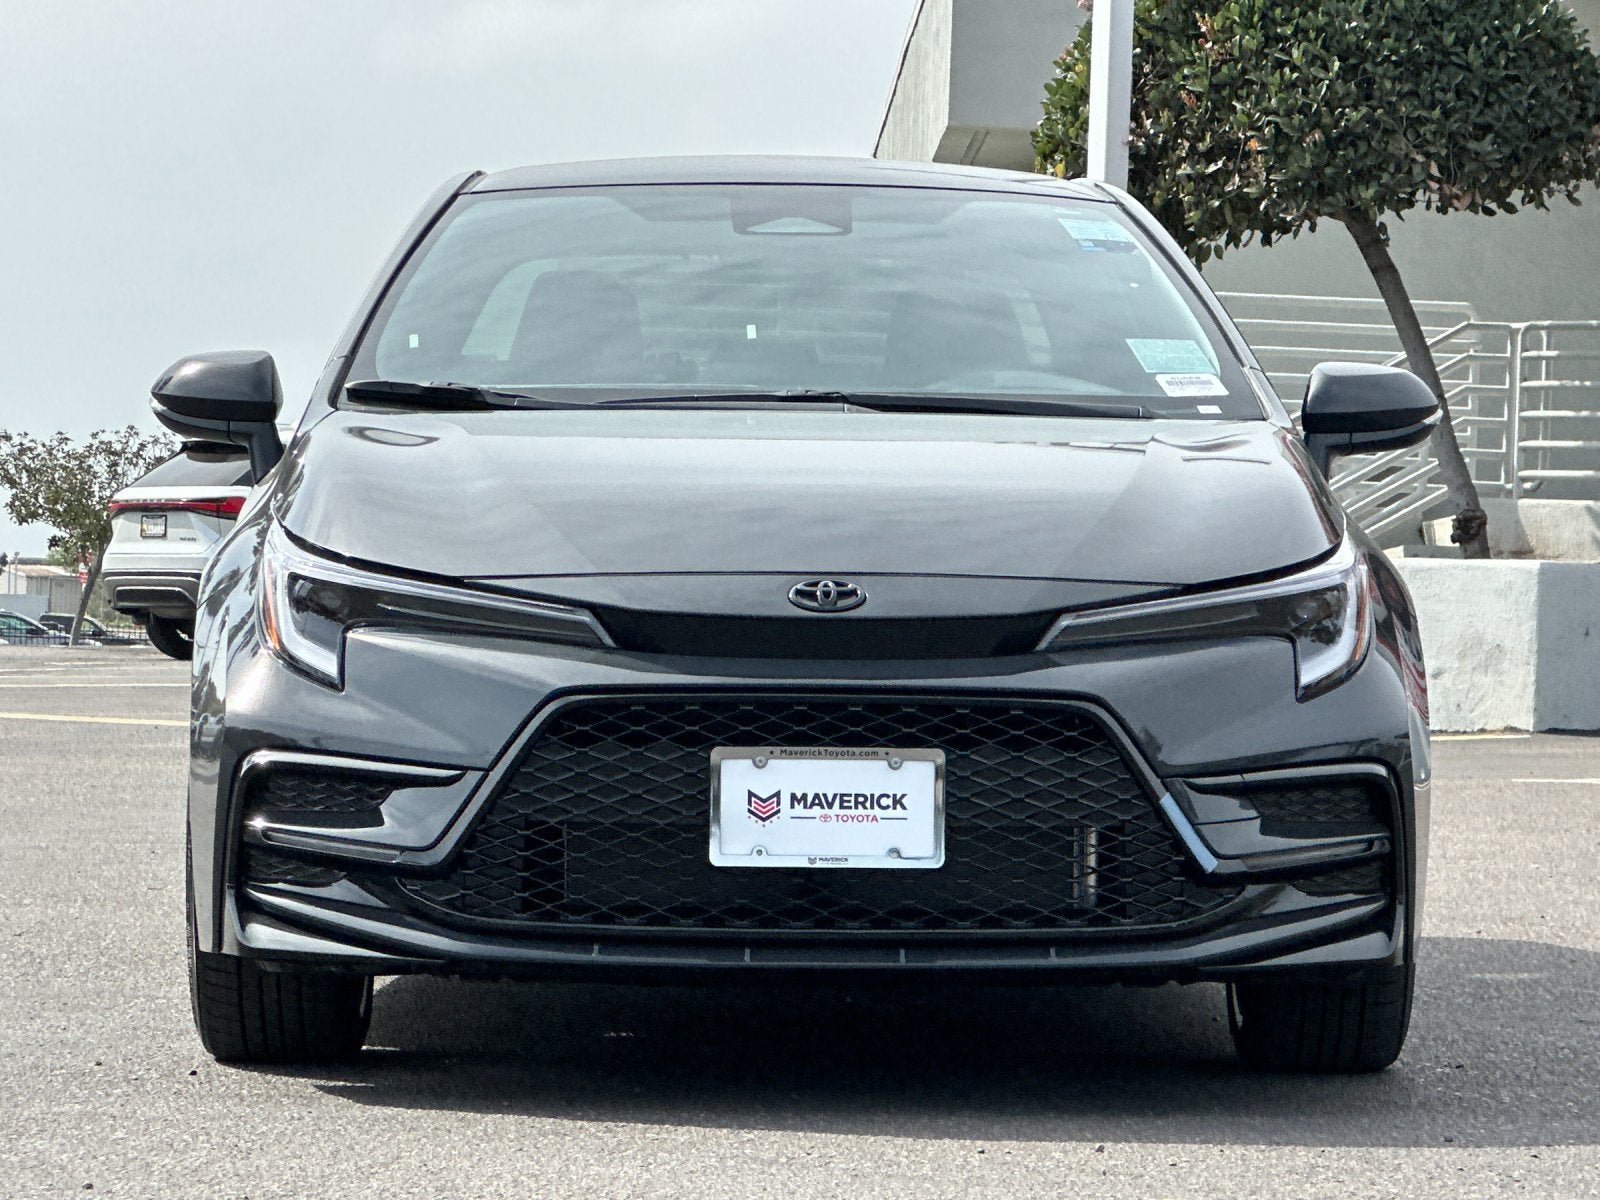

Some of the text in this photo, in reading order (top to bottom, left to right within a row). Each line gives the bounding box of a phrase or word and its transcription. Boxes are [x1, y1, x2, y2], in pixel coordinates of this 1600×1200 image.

[779, 749, 879, 757] MaverickToyota.com
[790, 792, 908, 811] MAVERICK
[834, 814, 879, 823] TOYOTA
